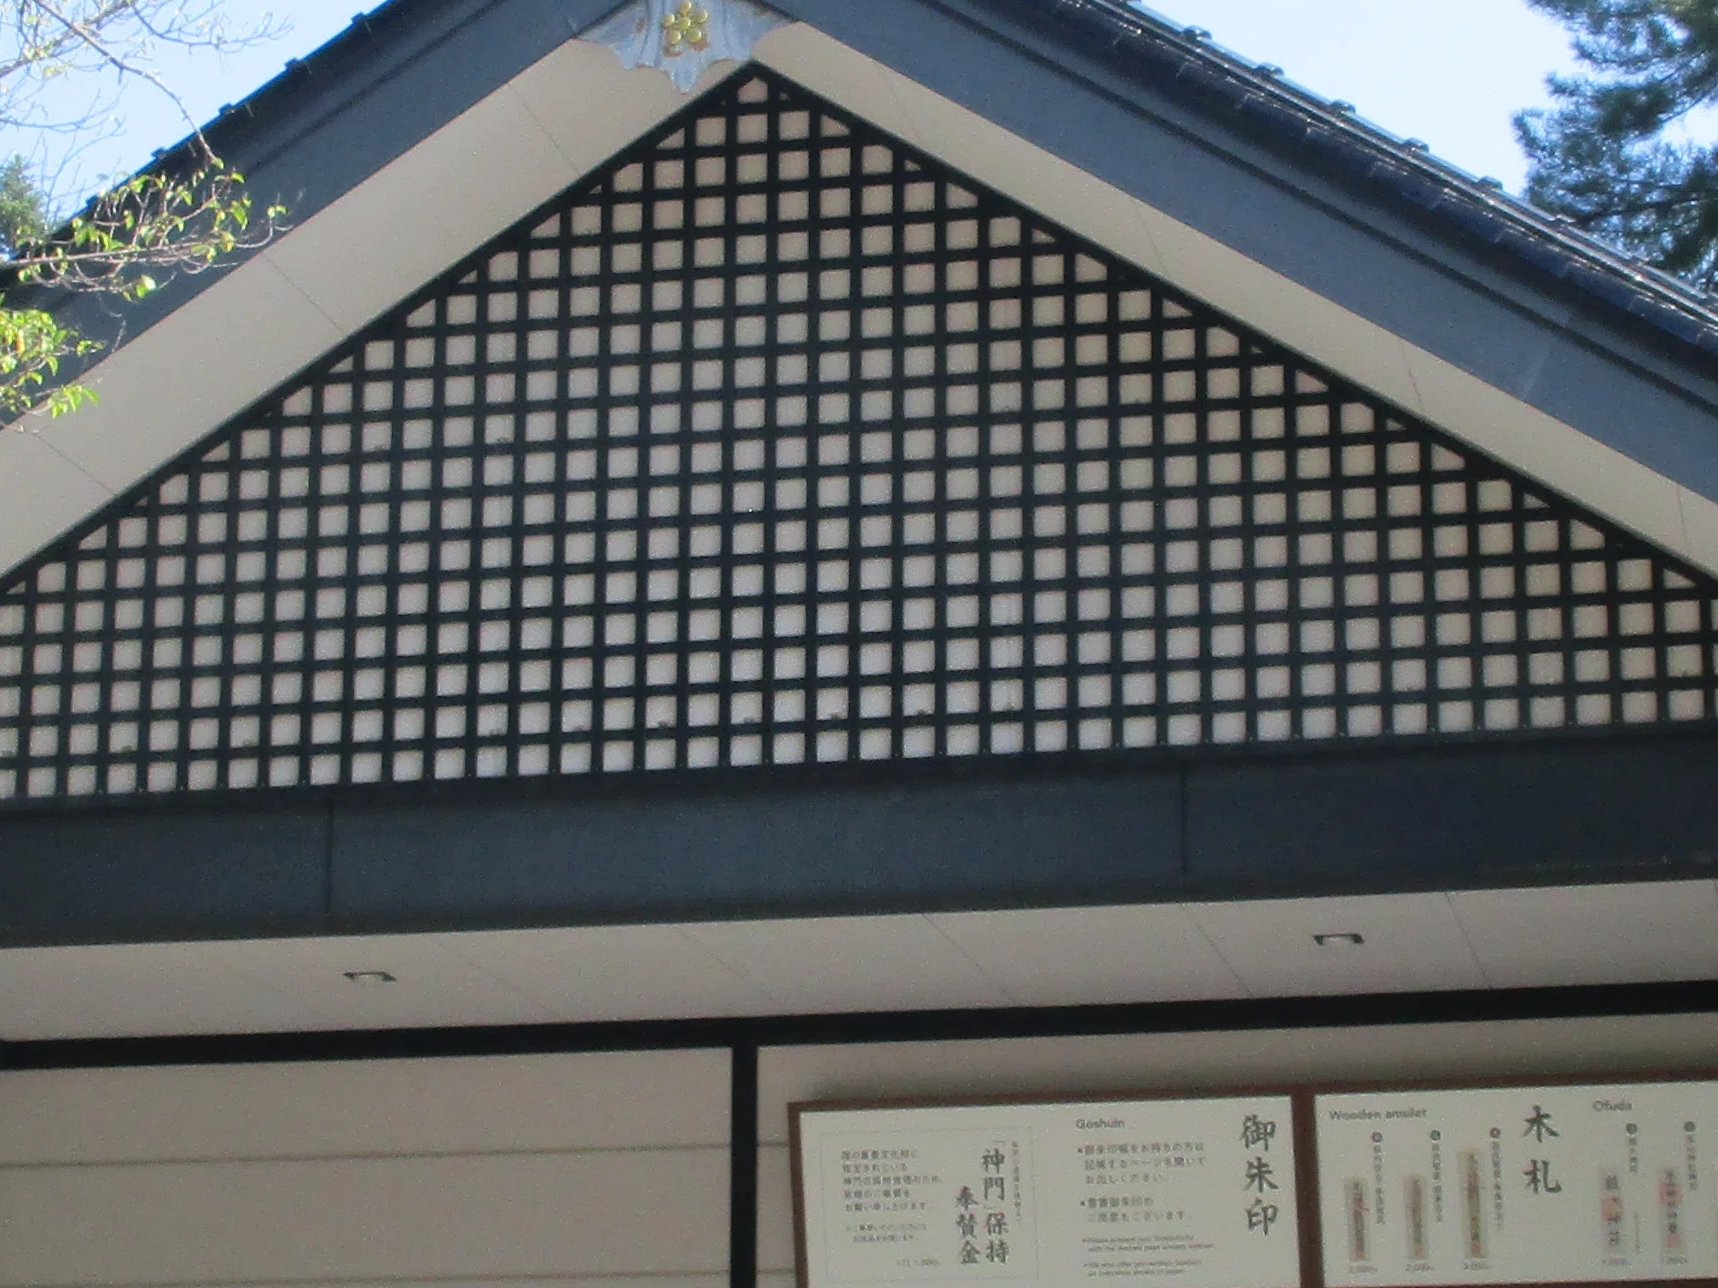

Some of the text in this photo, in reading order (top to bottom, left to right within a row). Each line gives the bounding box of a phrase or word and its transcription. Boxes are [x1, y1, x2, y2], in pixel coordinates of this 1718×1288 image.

[1075, 1118, 1125, 1130] Goshuin
[1329, 1110, 1381, 1121] Wooden
[1523, 1104, 1562, 1195] 木札
[1240, 1114, 1279, 1236] 御朱印
[955, 1186, 981, 1264] 奉賛金
